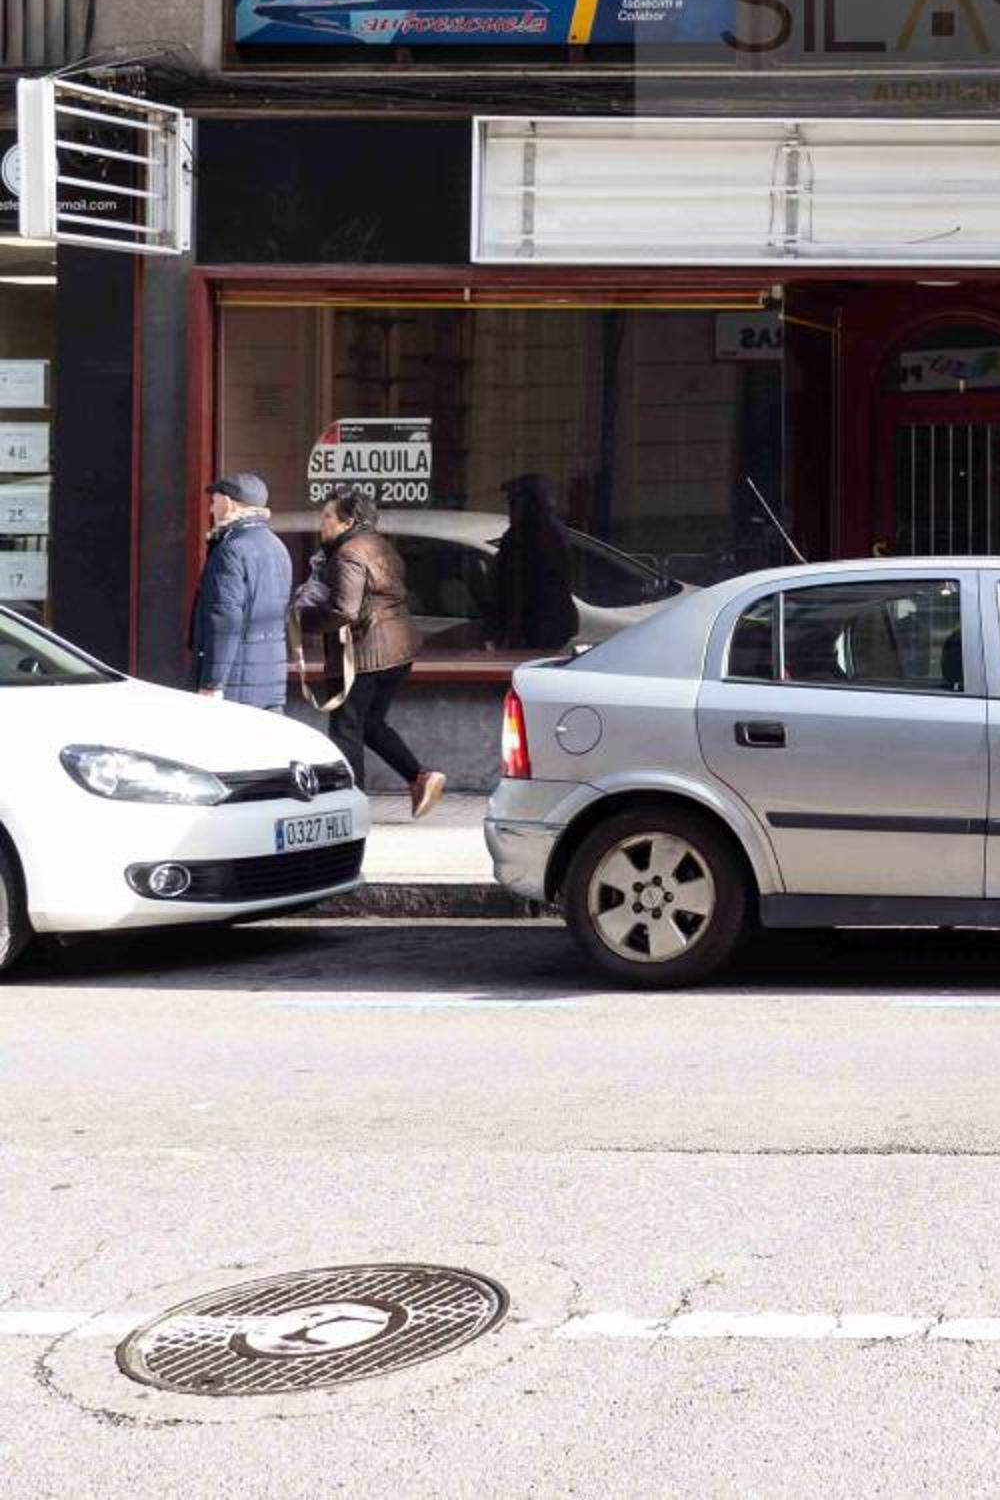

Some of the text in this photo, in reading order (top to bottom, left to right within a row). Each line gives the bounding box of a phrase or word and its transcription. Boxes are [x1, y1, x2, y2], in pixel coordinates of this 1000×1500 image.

[311, 449, 430, 474] SE ALQUILA
[381, 482, 430, 502] 2000
[287, 818, 322, 845] 0327
